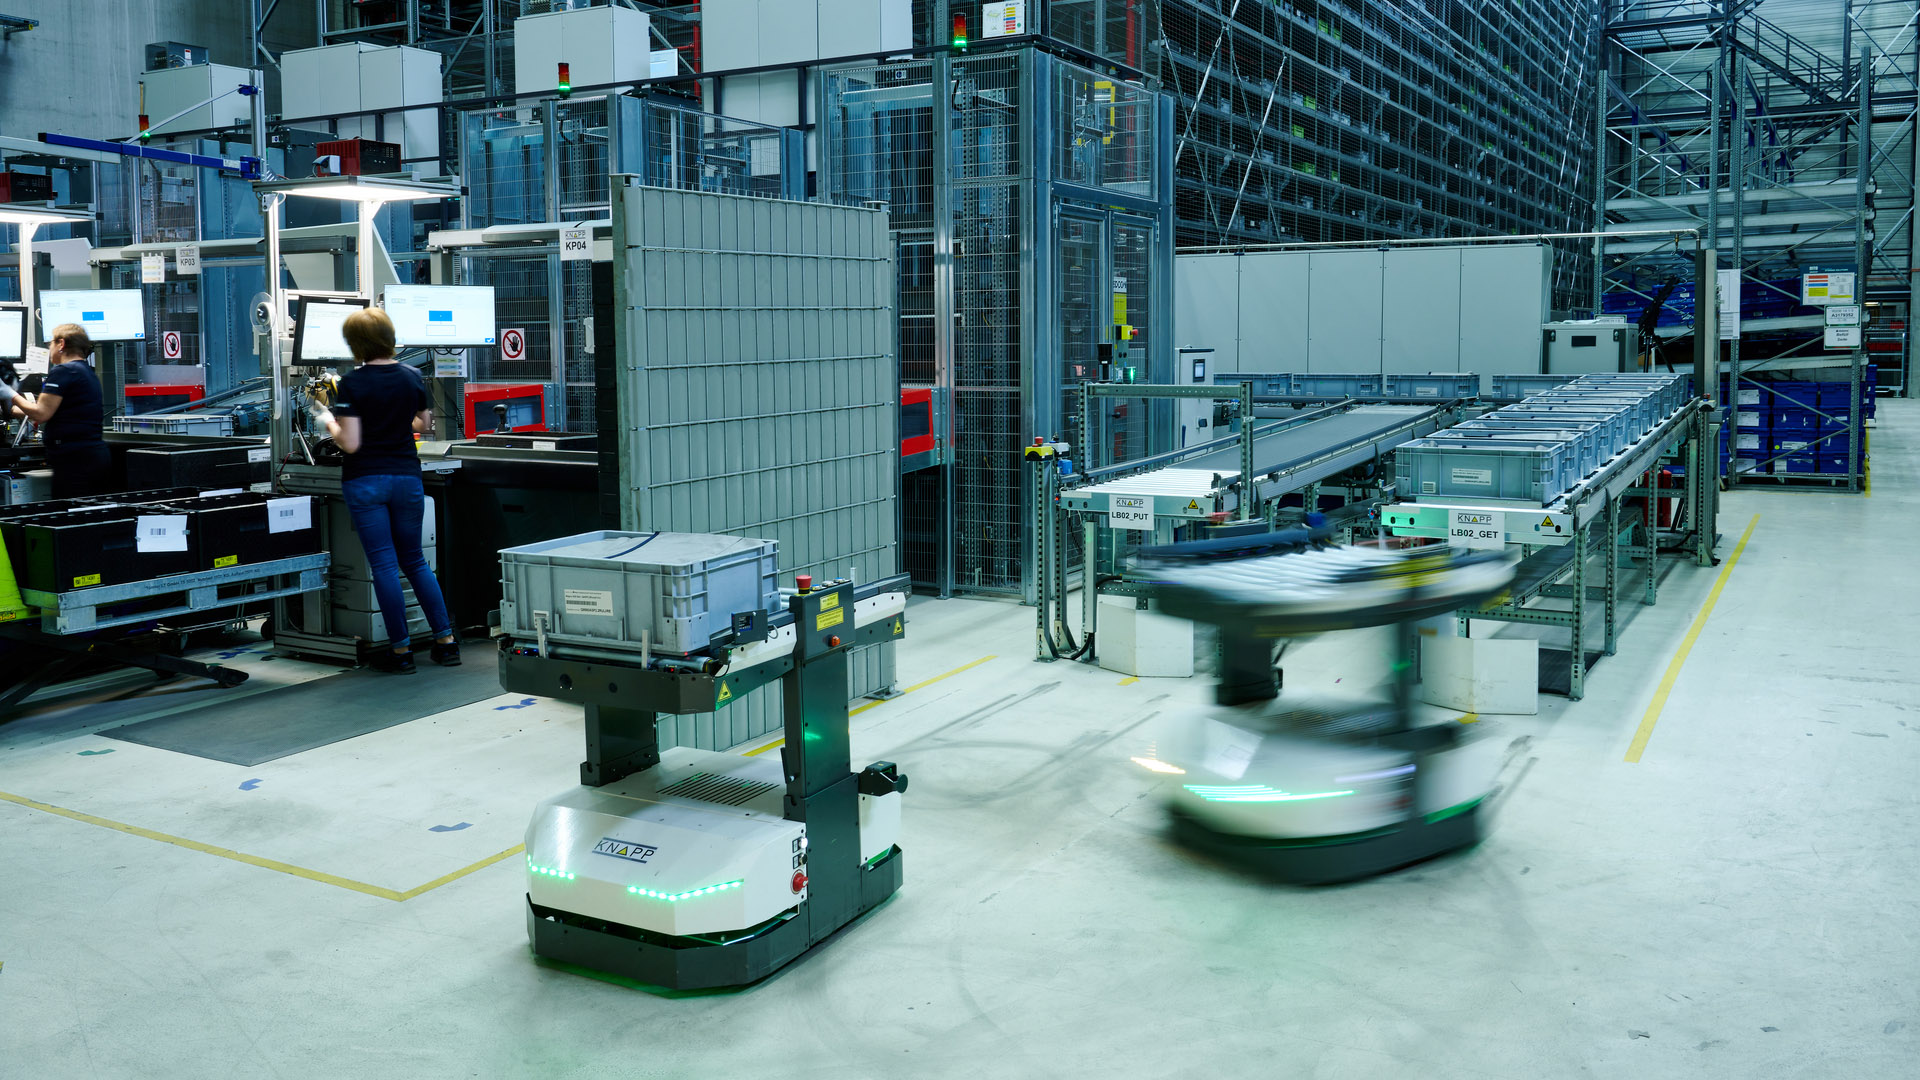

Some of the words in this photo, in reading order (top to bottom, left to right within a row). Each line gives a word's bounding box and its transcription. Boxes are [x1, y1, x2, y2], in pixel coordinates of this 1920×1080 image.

[565, 241, 587, 251] KP04
[180, 258, 195, 266] KP03
[1111, 511, 1149, 521] LB02_PUT
[1457, 514, 1492, 523] KNAPP
[1451, 528, 1499, 539] LB02_GET
[594, 840, 655, 860] KNAPP
